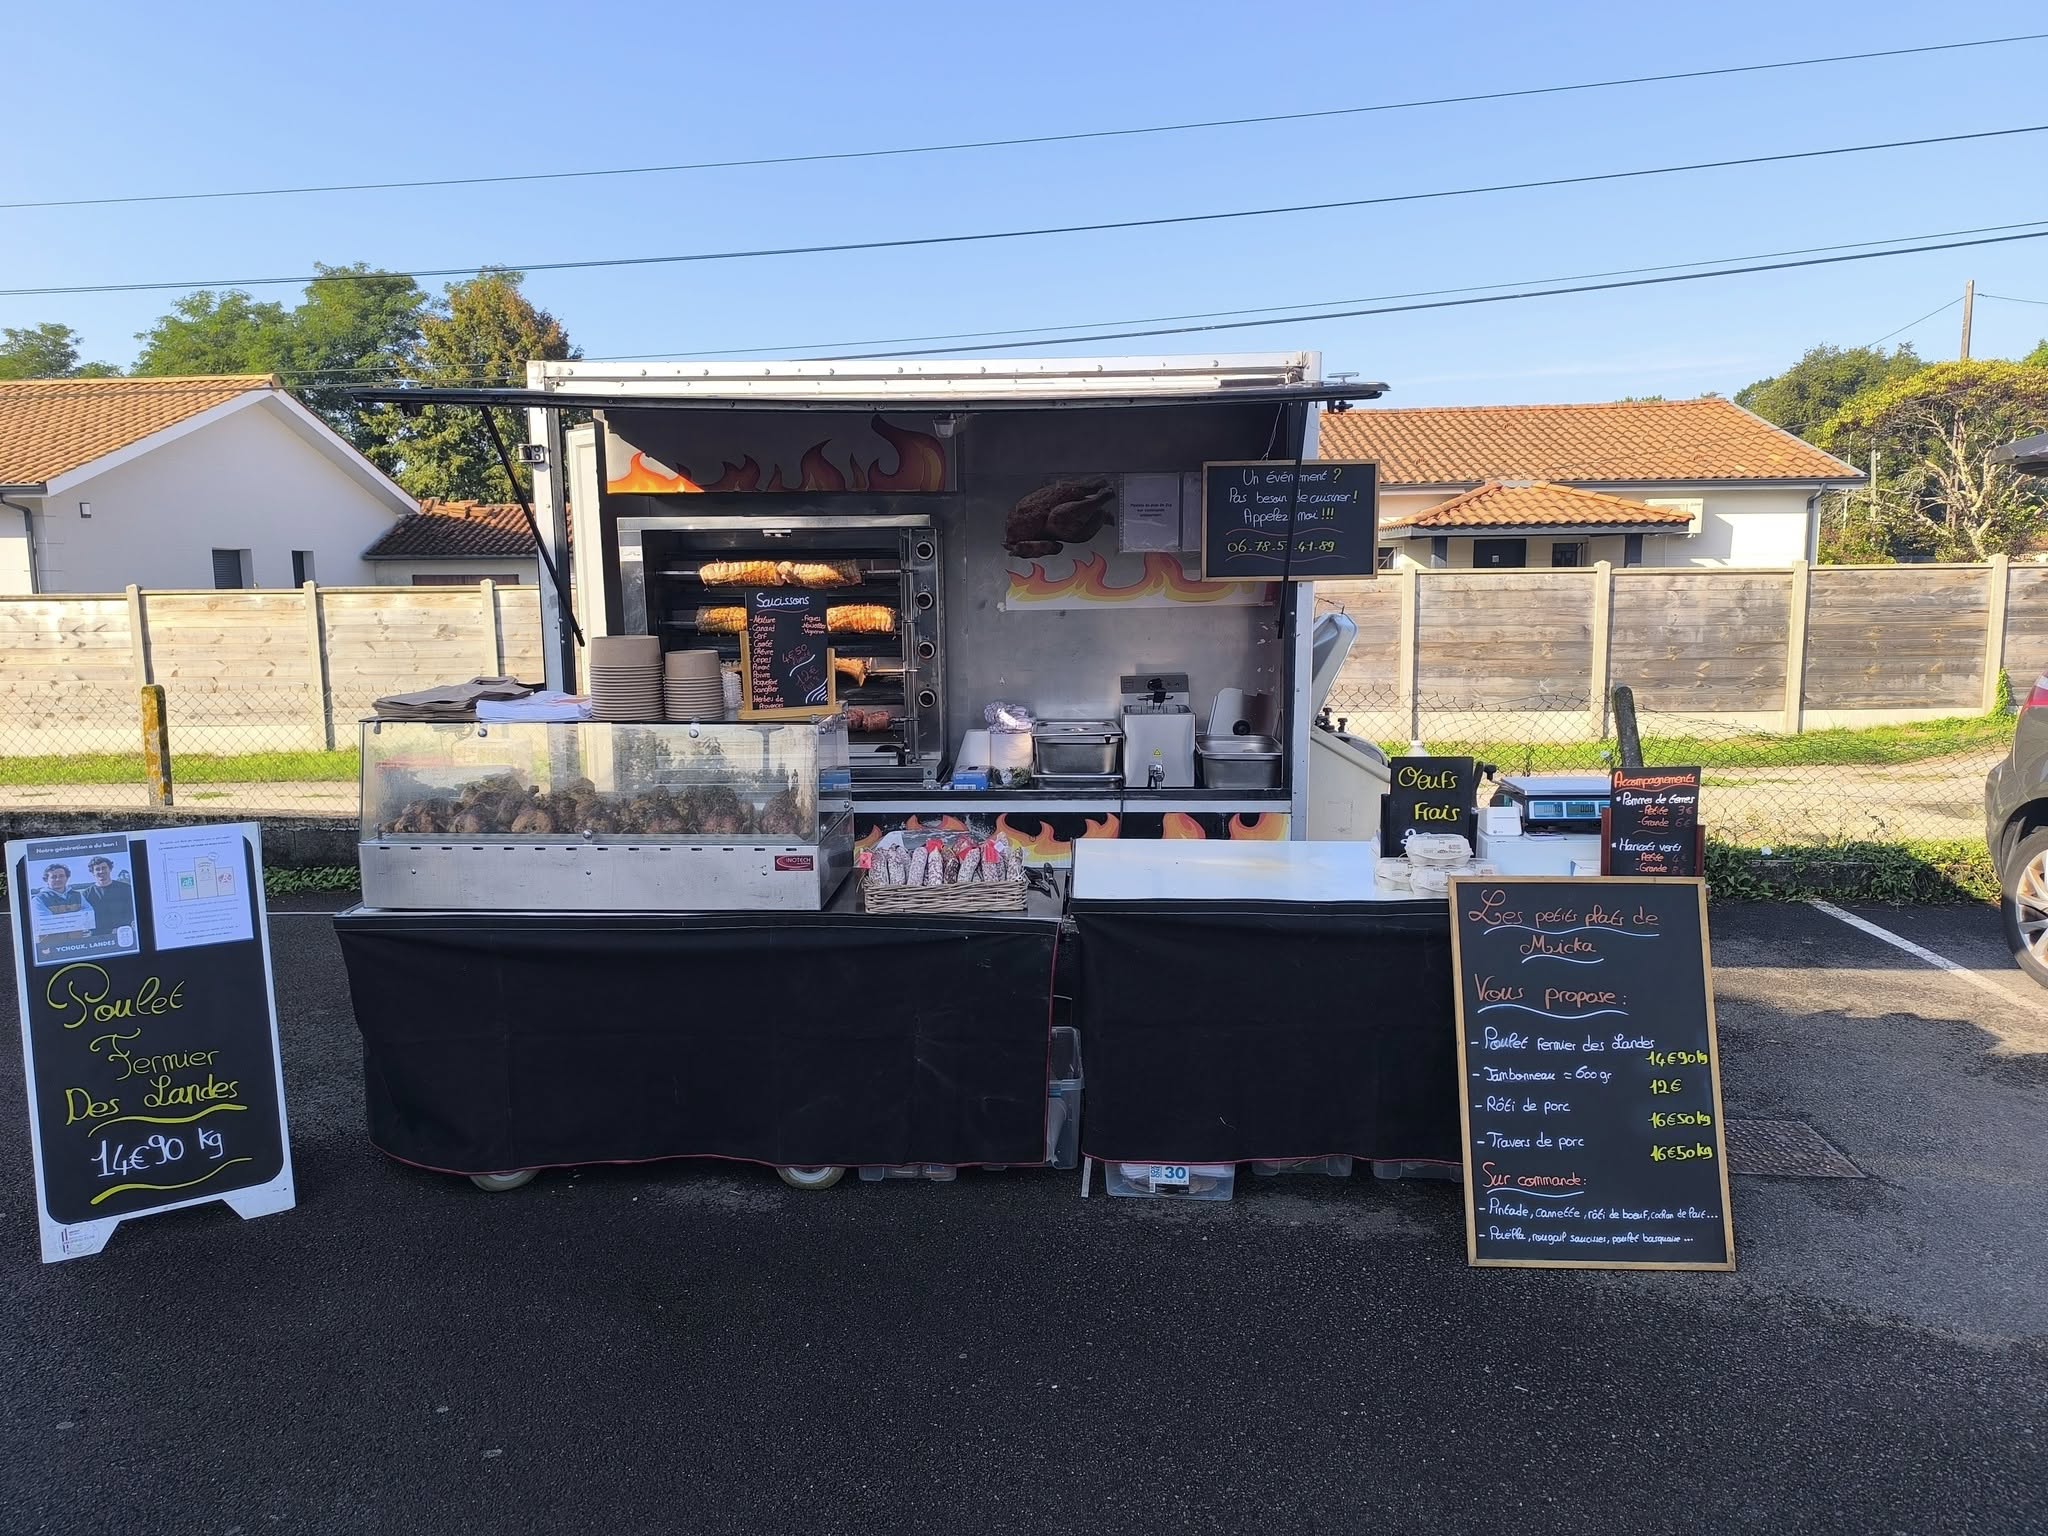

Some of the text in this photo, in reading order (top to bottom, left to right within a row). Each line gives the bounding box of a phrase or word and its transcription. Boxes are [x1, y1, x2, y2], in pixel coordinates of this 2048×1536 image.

[1242, 469, 1259, 486] Un
[1266, 470, 1328, 484] événment
[1229, 487, 1248, 504] Pas
[1256, 491, 1288, 504] besoin
[1244, 508, 1288, 528] Appelez
[756, 592, 810, 608] Saucissons
[752, 624, 775, 632] Canard
[1614, 770, 1696, 789] Accompagnements
[1622, 791, 1653, 806] Pommes
[1655, 793, 1667, 804] de
[1414, 801, 1461, 822] Frais
[1644, 804, 1669, 815] Petite
[1641, 816, 1670, 827] Grande
[1619, 838, 1656, 852] Haricots
[1639, 862, 1668, 873] Grande
[1468, 889, 1660, 928] Les petits plats de
[46, 962, 185, 1029] Poulet
[1474, 973, 1524, 1002] Vous
[1484, 1026, 1529, 1050] Poulet
[1582, 1034, 1605, 1052] des
[1612, 1033, 1656, 1050] Landes
[89, 1027, 220, 1081] Fermier
[1483, 1066, 1556, 1082] Jambonneau
[1575, 1065, 1598, 1080] 600
[65, 1073, 239, 1126] Des Landes
[1486, 1095, 1571, 1115] Rôti de porc
[1486, 1131, 1585, 1150] Travers de porc
[90, 1127, 224, 1178] 14€90 kg
[1164, 1166, 1187, 1180] 30
[1482, 1161, 1512, 1188] Sur
[1608, 1206, 1620, 1219] de
[1677, 1208, 1687, 1219] de
[1612, 1231, 1640, 1245] poulet
